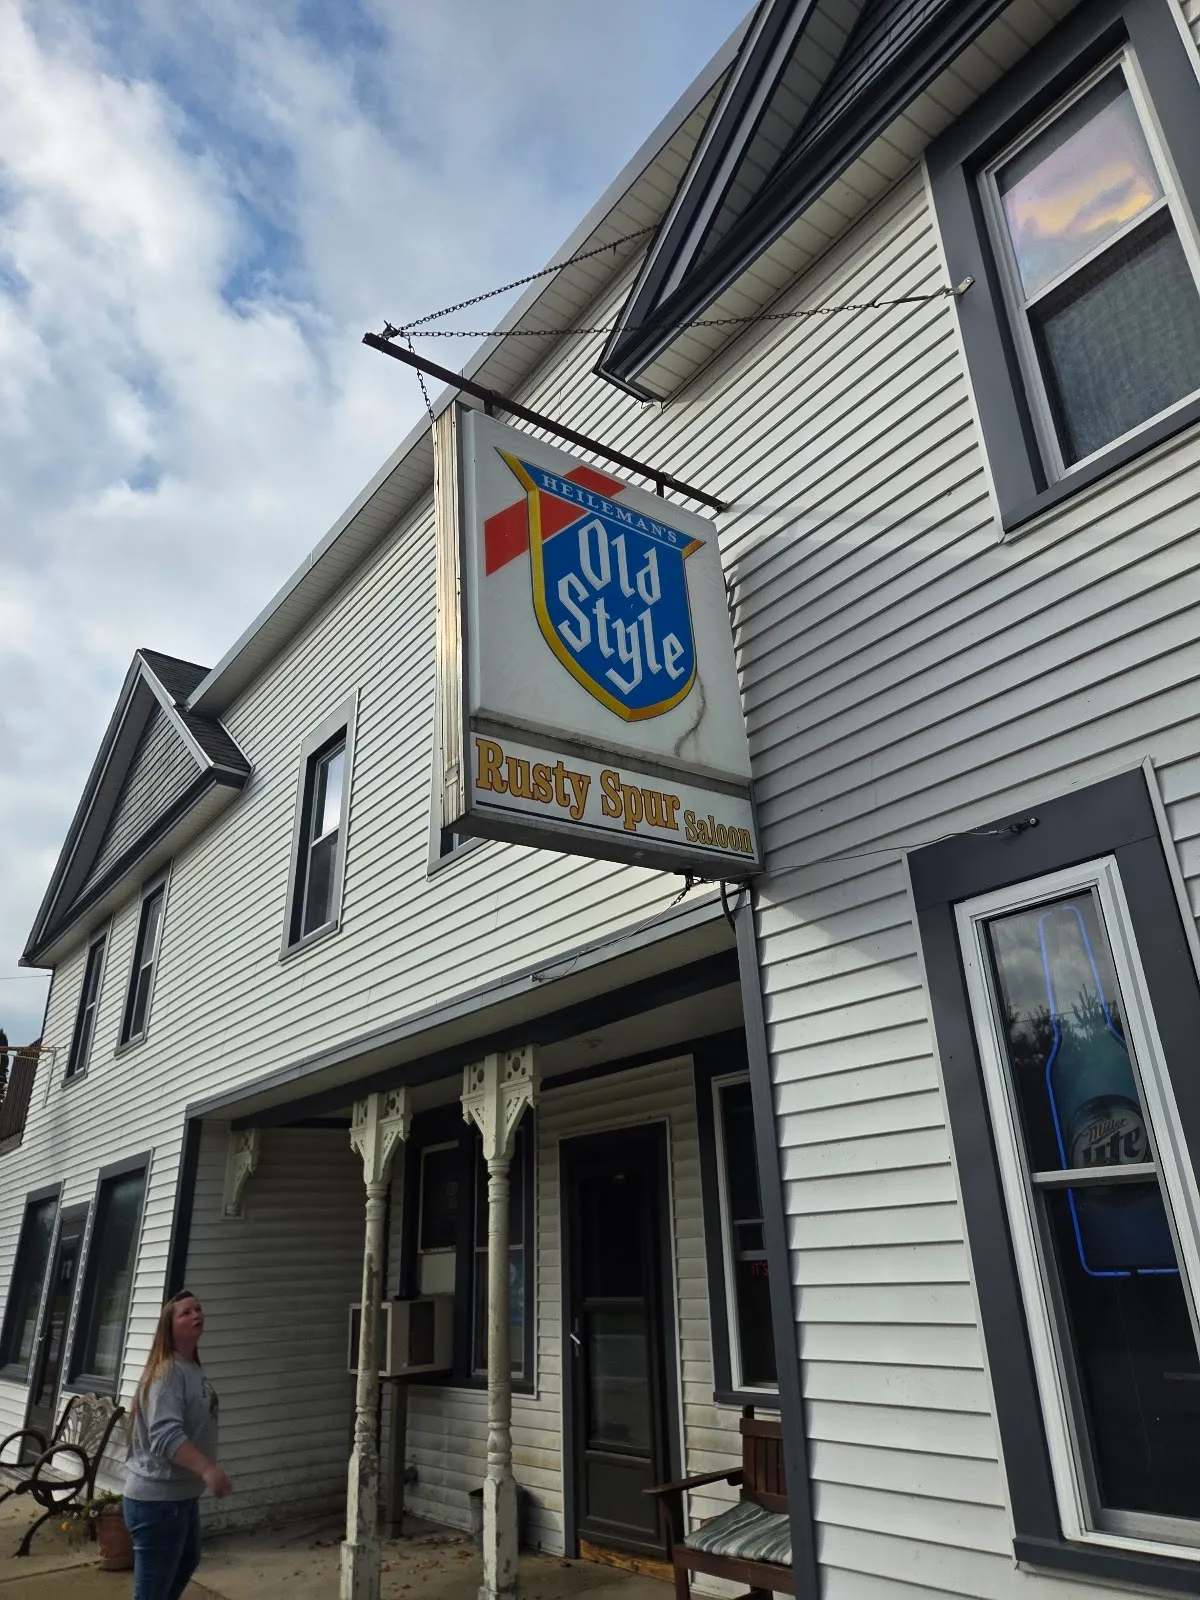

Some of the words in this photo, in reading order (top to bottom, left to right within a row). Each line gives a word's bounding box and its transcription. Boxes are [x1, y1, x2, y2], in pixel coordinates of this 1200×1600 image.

[541, 474, 678, 543] HEILEMAN'S
[578, 518, 662, 606] Old
[557, 572, 685, 695] Style
[475, 737, 592, 820] Rusty
[600, 769, 681, 831] Spur
[684, 809, 754, 853] Saloon
[1088, 1118, 1128, 1144] Miller
